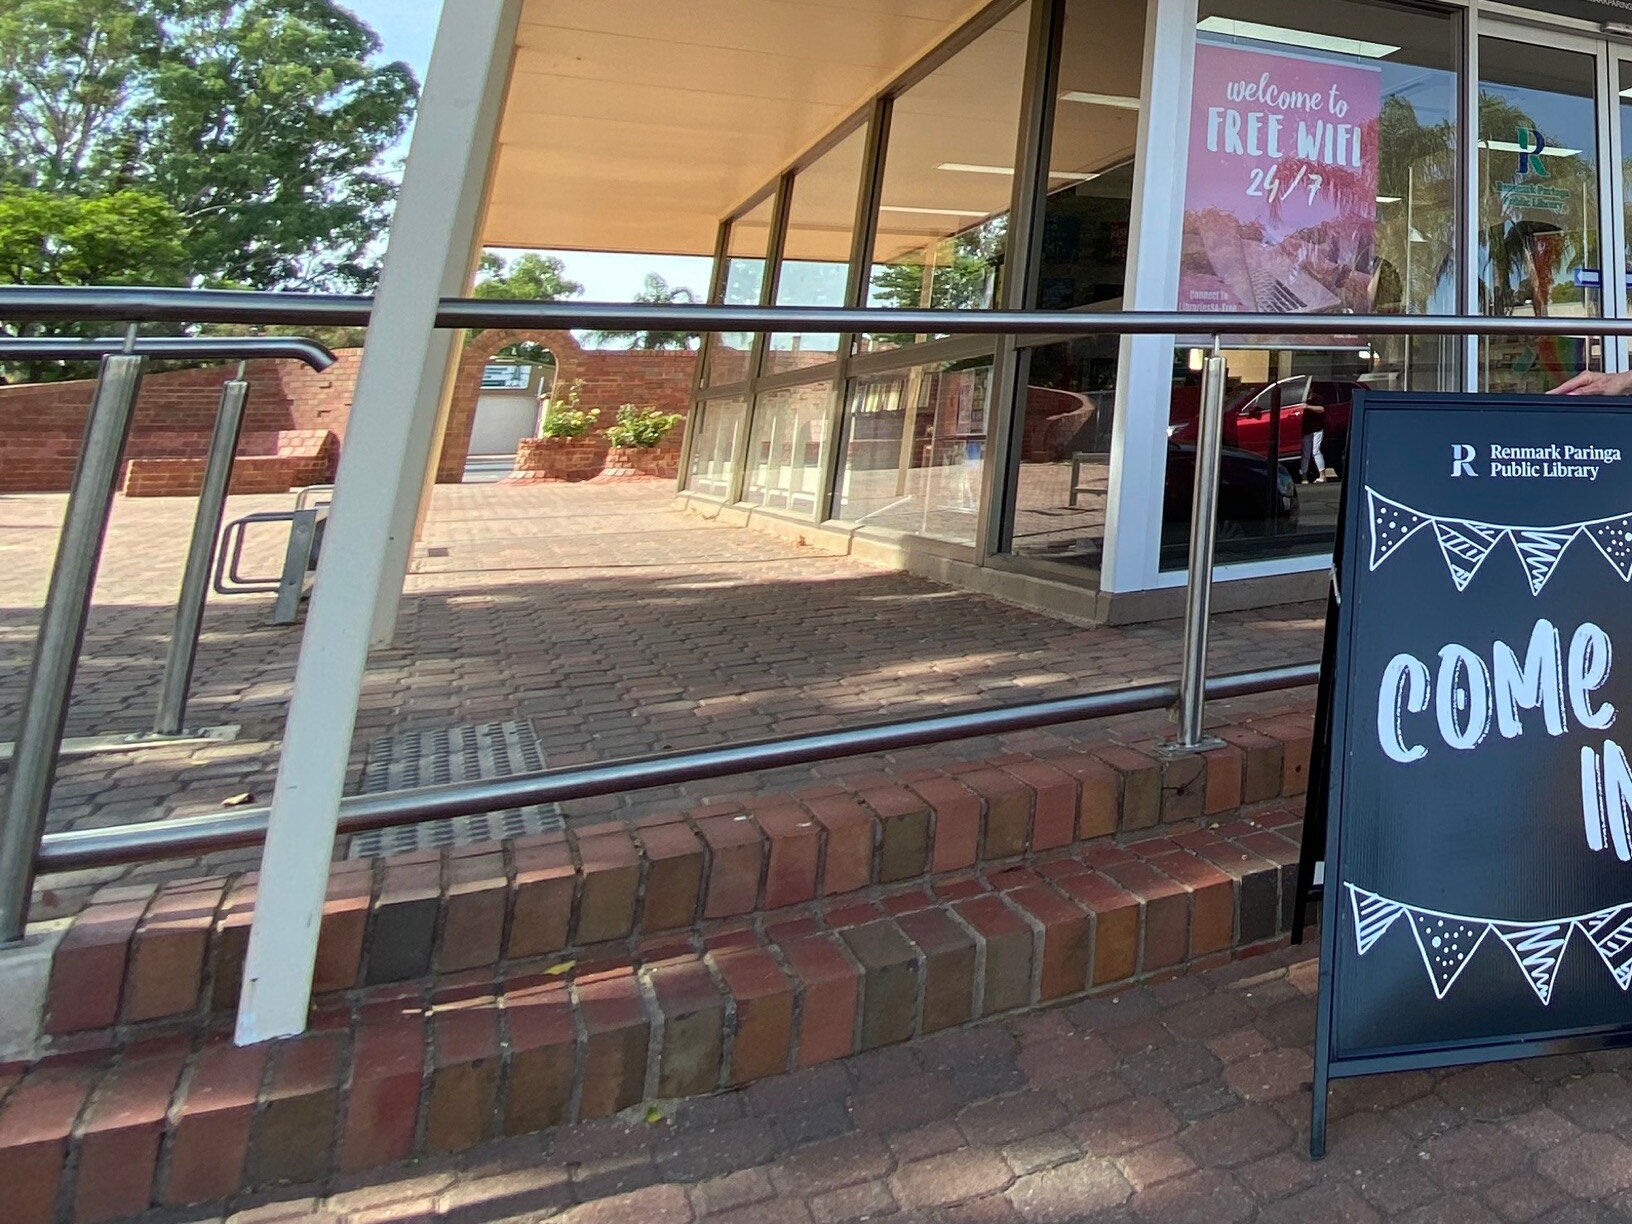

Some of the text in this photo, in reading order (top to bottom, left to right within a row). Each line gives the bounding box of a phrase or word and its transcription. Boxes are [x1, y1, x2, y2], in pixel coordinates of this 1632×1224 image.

[1226, 72, 1348, 118] welcome to
[1206, 107, 1362, 167] FREE WIFI
[1245, 164, 1323, 206] 24/7
[1490, 444, 1622, 463] Renmark Paringa
[1490, 461, 1599, 481] Public Library
